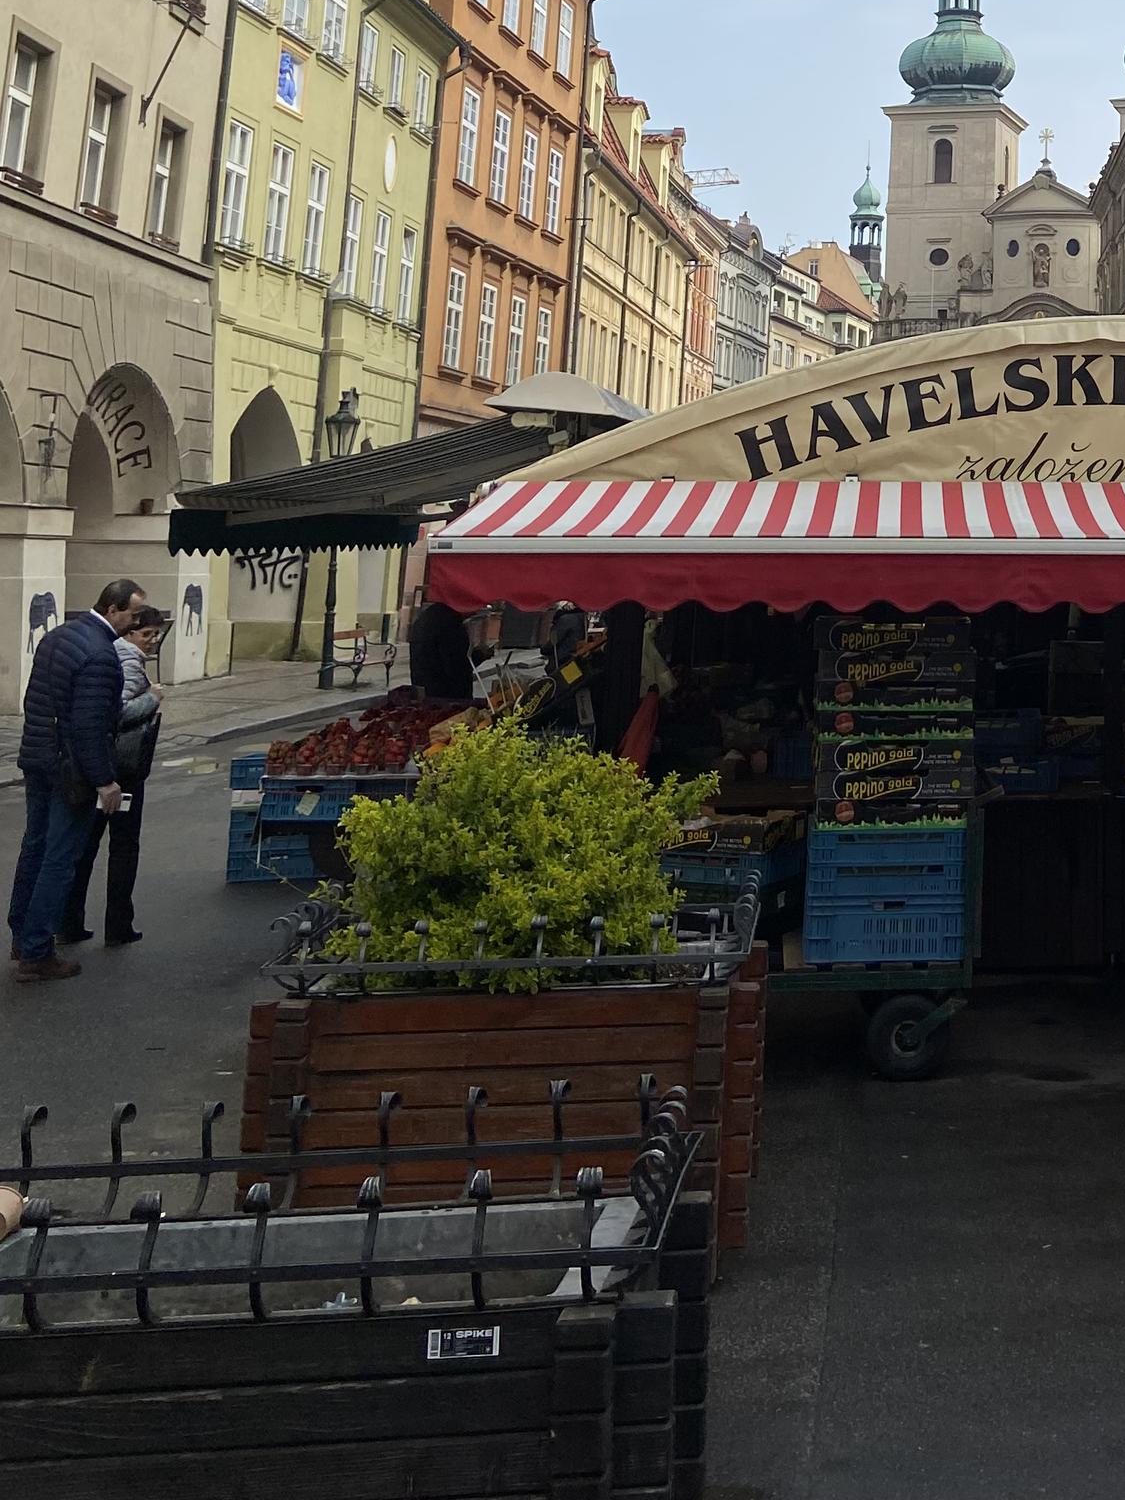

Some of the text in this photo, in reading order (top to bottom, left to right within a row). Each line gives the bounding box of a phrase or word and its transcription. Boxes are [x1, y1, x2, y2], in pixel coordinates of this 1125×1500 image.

[884, 630, 908, 642] gold
[890, 660, 914, 671] gold
[889, 748, 914, 760] gold
[888, 777, 912, 789] gold
[687, 829, 709, 841] gold
[455, 1329, 493, 1339] SPIKE
